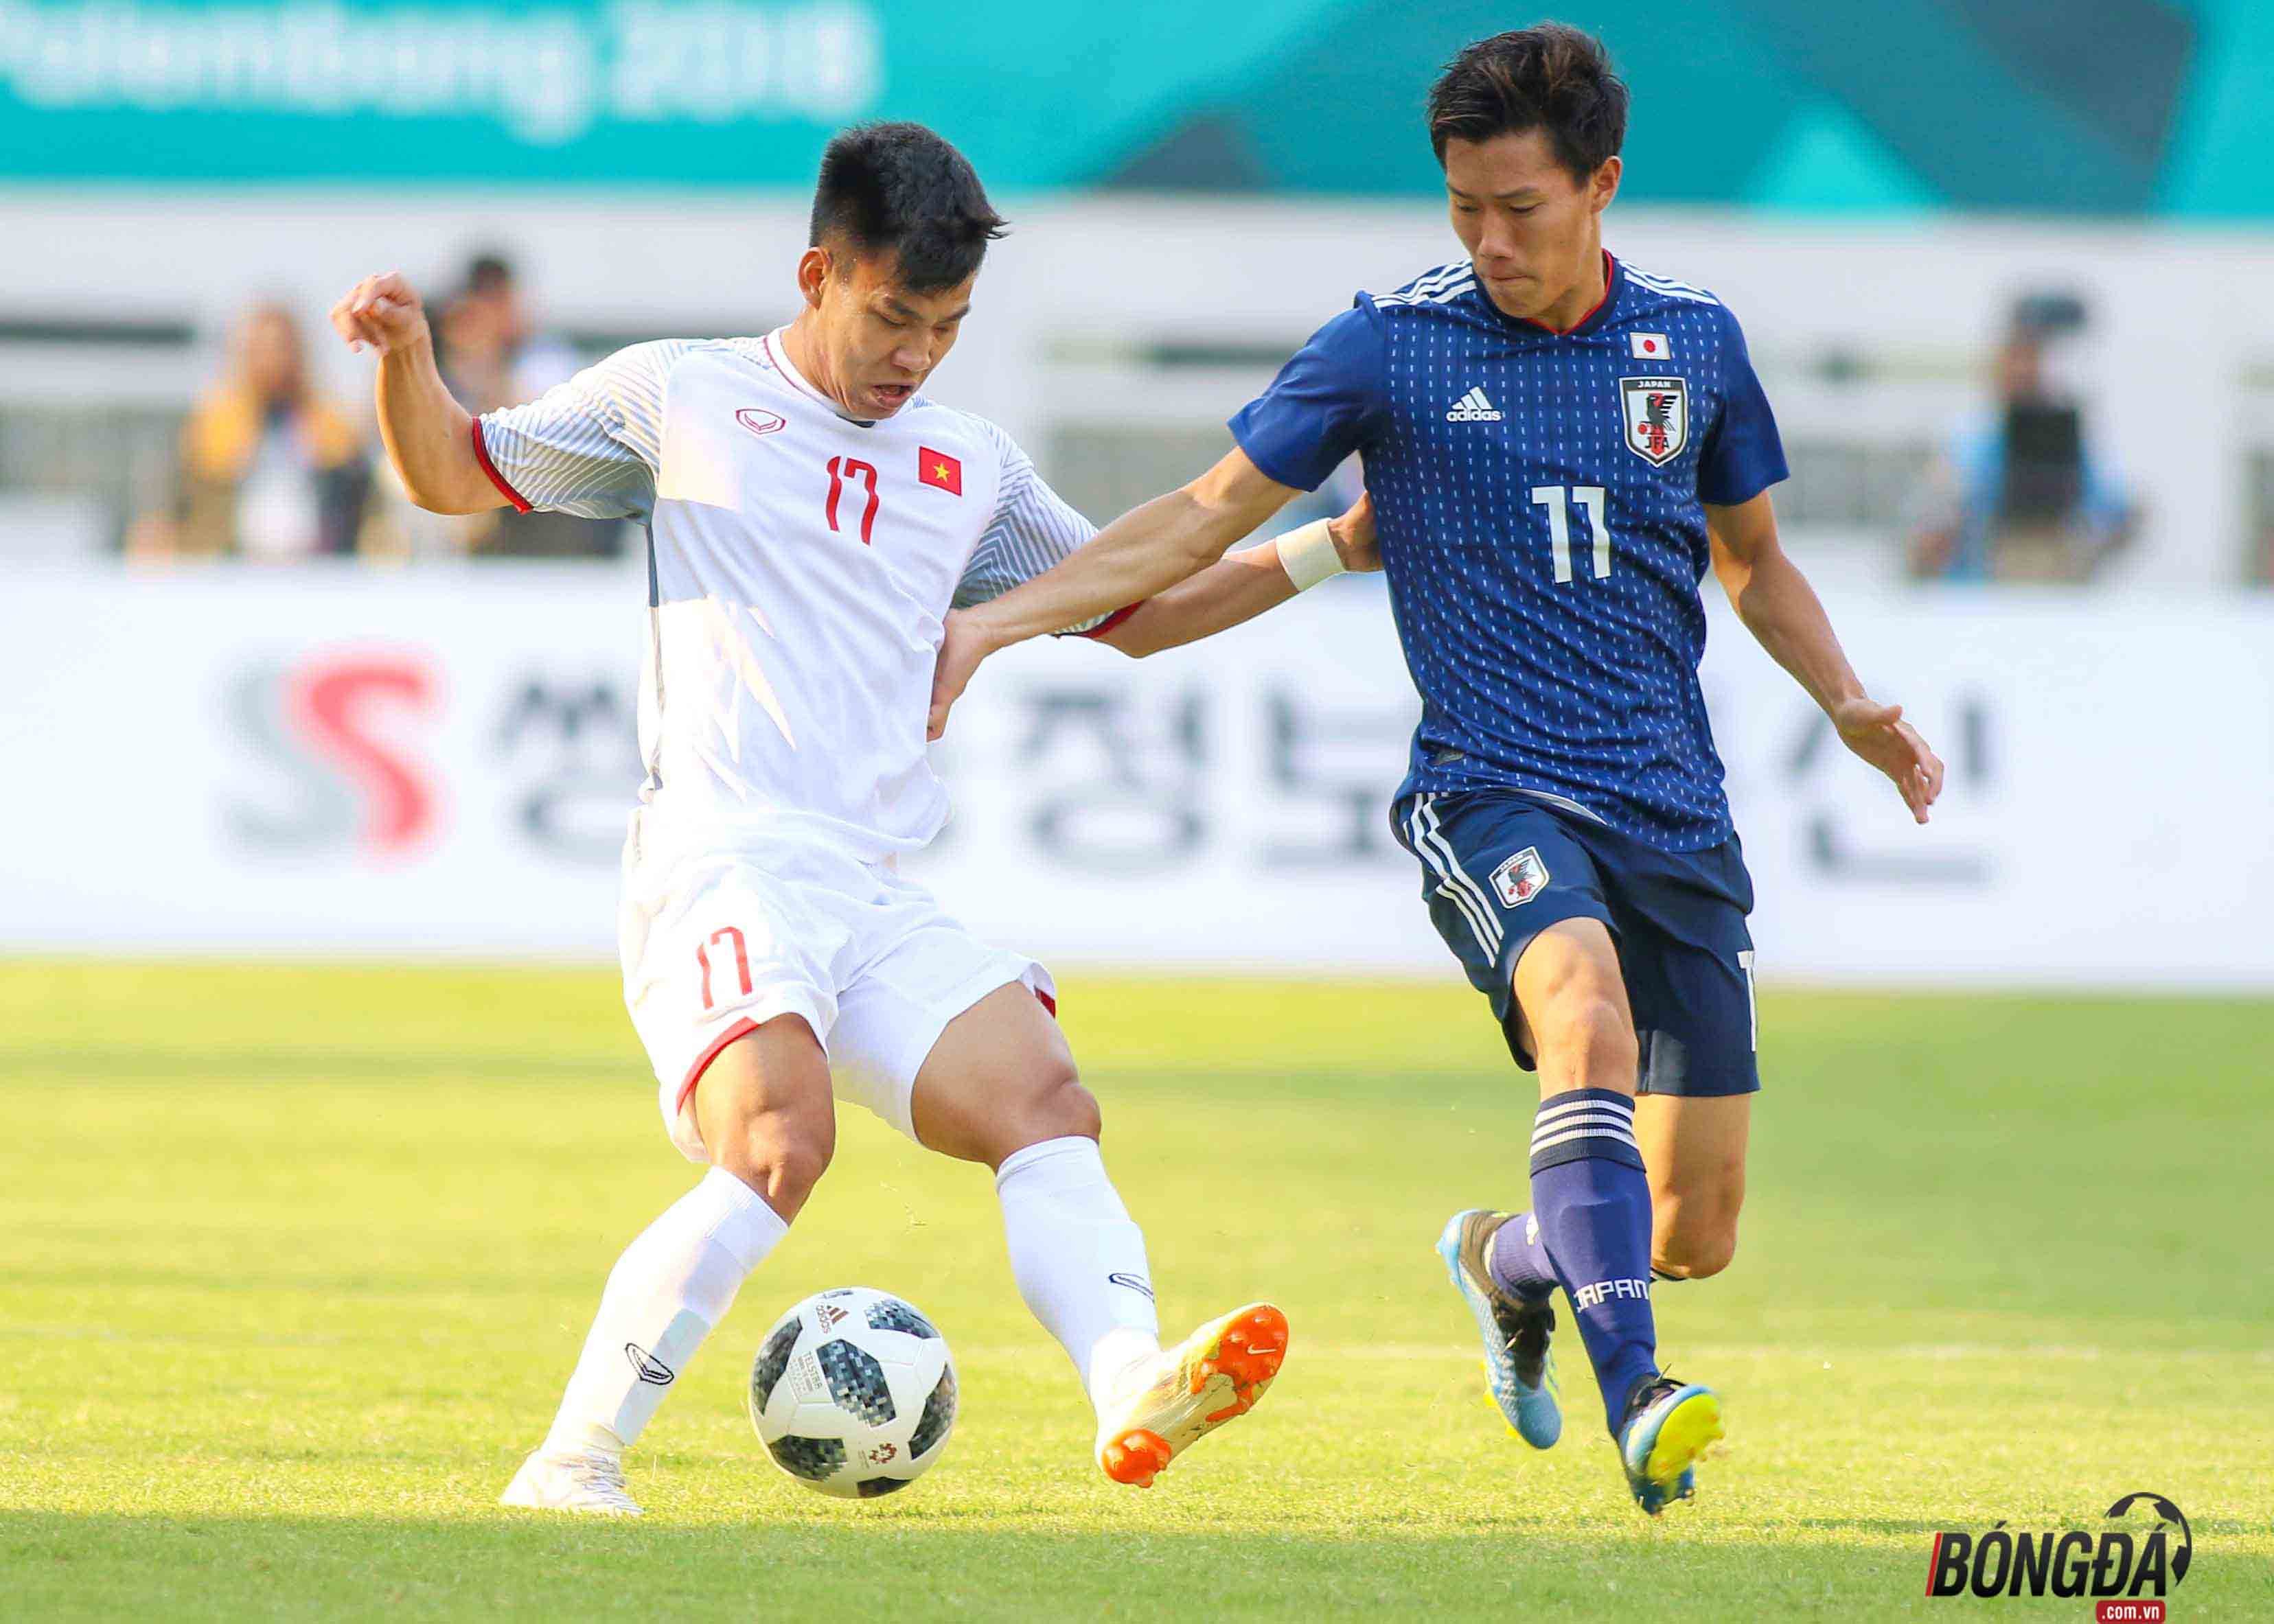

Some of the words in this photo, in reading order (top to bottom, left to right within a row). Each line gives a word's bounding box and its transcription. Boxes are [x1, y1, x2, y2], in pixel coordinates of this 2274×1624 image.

[1446, 406, 1502, 422] adidas
[826, 456, 880, 547] 17
[1532, 486, 1611, 583] 11
[696, 927, 753, 1010] 17
[1574, 1279, 1649, 1314] JAPAN
